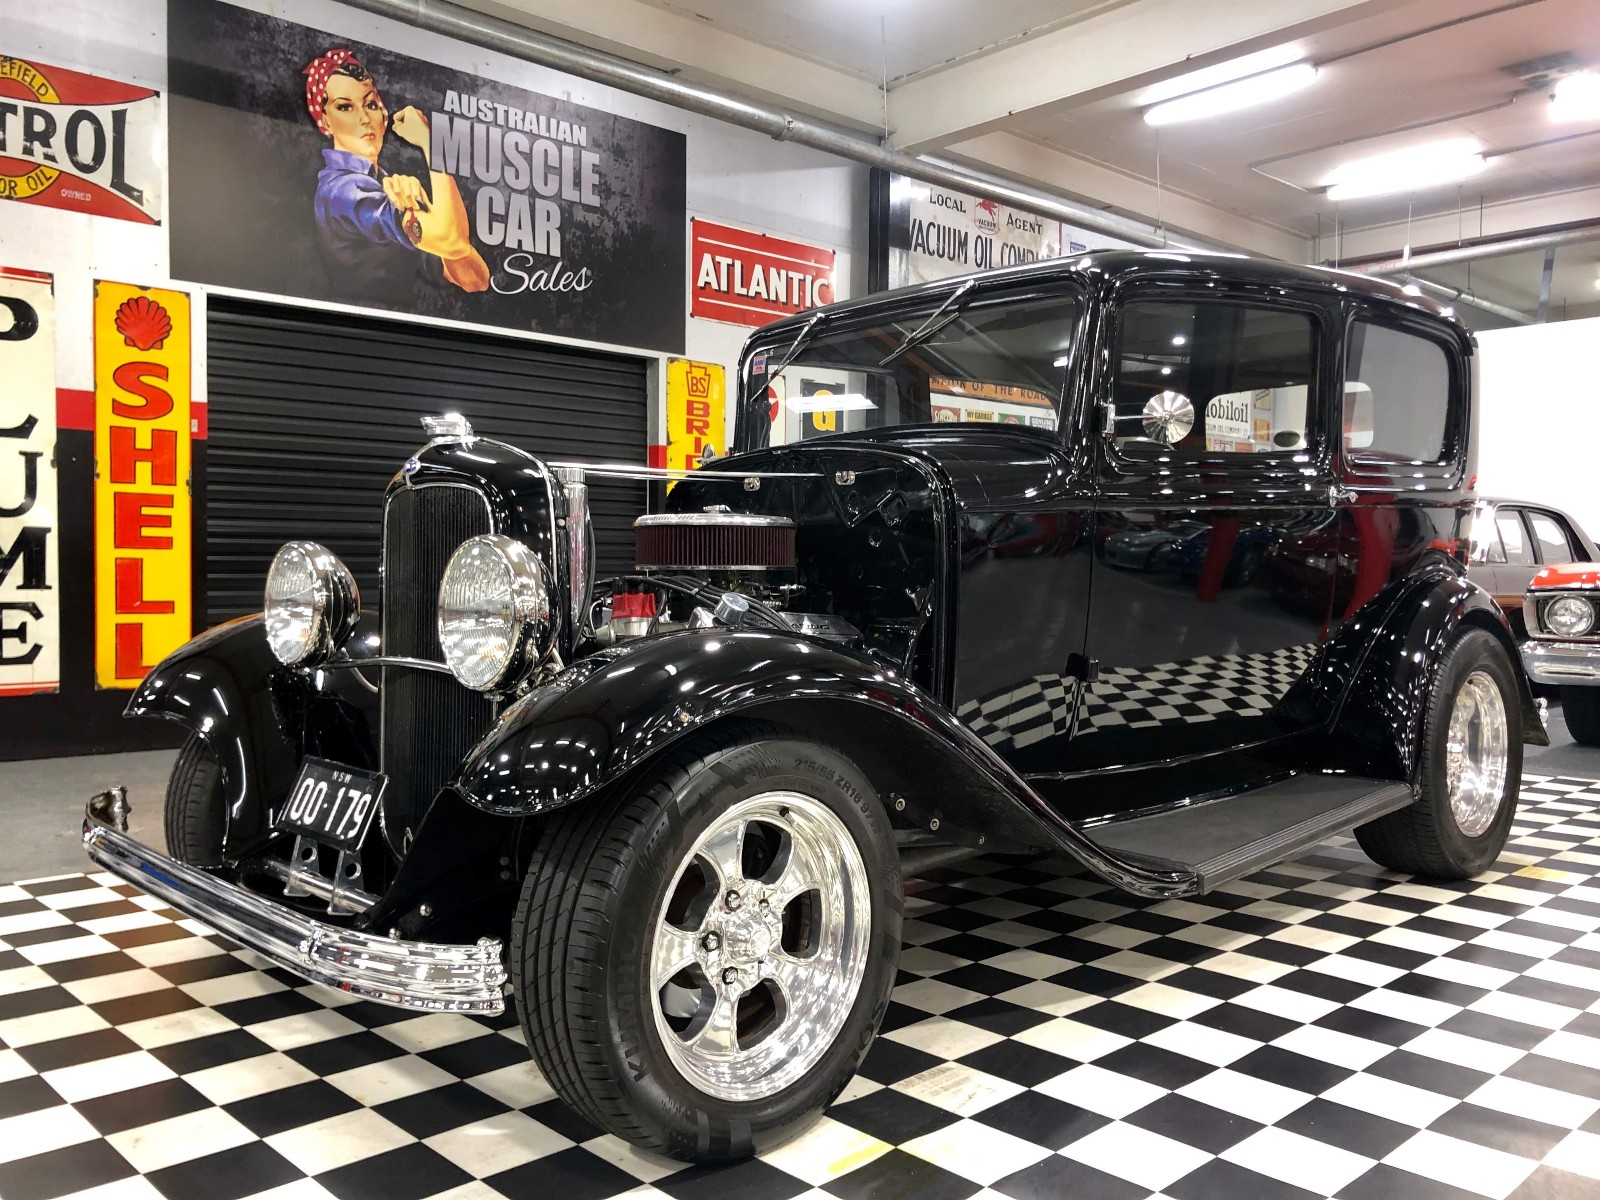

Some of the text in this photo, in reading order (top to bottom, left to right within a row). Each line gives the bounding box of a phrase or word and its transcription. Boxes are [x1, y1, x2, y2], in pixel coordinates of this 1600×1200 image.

[443, 89, 587, 147] AUSTRALIAN
[26, 169, 53, 191] OIL
[431, 111, 601, 207] MUSCLE
[475, 185, 561, 257] CAR
[929, 187, 1043, 236] LOCAL AGENT
[974, 234, 996, 270] OIL
[489, 253, 594, 295] Sales
[697, 252, 831, 308] ATLANTIC
[690, 376, 707, 394] BS
[994, 385, 1014, 396] THE
[109, 361, 179, 680] SHELL
[331, 770, 353, 784] NSW
[834, 775, 863, 804] ZR16
